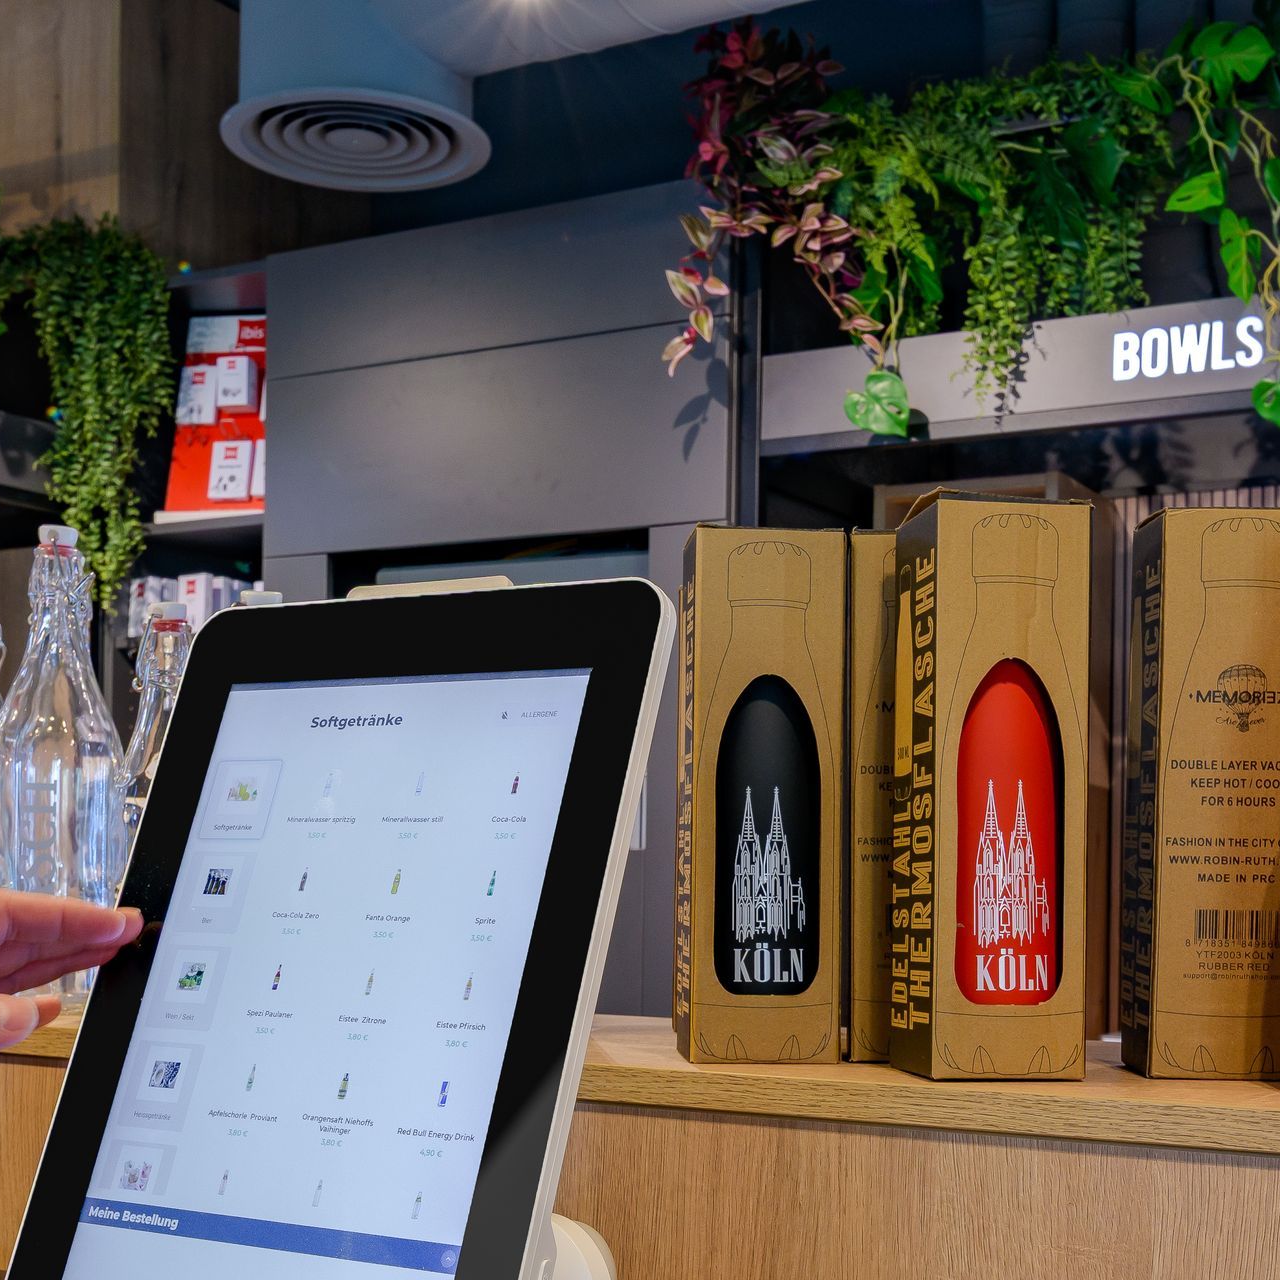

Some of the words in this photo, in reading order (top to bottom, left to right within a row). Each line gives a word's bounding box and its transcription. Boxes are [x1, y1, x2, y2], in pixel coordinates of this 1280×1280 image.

[1112, 316, 1264, 382] BOWLS
[310, 713, 403, 730] Softgetränke
[1171, 759, 1218, 770] DOUBLE
[1221, 760, 1258, 771] LAYER
[908, 547, 936, 1030] THERMOSFLASCHE
[1190, 778, 1221, 789] KEEP
[1223, 778, 1247, 789] HOT
[1201, 796, 1224, 806] FOR
[1227, 797, 1233, 807] 6
[1236, 797, 1276, 807] HOURS
[332, 816, 356, 825] spritzig
[213, 824, 252, 832] Softgetränke
[1165, 837, 1213, 847] FASHION
[1215, 837, 1224, 847] IN
[1228, 837, 1249, 848] THE
[1251, 838, 1275, 848] CITY
[1197, 873, 1230, 883] MADE
[1235, 874, 1247, 883] IN
[1252, 874, 1276, 884] PRC
[272, 911, 303, 919] Coca-Cola
[385, 914, 411, 924] Orange
[891, 801, 911, 1029] EDELSTAHL
[475, 917, 496, 926] Sprite
[1196, 950, 1242, 959] YTF2003
[1244, 950, 1275, 960] KÖLN
[733, 942, 805, 984] KÖLN
[1198, 962, 1244, 971] RUBBER
[1247, 963, 1271, 972] RED
[975, 948, 1048, 991] KÖLN
[247, 1009, 264, 1018] Spezi
[265, 1010, 293, 1019] Paulaner
[338, 1015, 359, 1023] Eistee
[361, 1016, 387, 1025] Zitrone
[436, 1021, 458, 1029] Eistee
[459, 1022, 486, 1031] Pfirsich
[208, 1109, 248, 1121] Apfelschorle
[250, 1113, 278, 1123] Proviant
[302, 1113, 345, 1128] Orangensaft
[345, 1117, 374, 1128] Niehoffs
[319, 1125, 351, 1136] Vaihinger
[396, 1127, 411, 1136] Red
[412, 1128, 427, 1137] Bull
[428, 1130, 454, 1142] Energy
[454, 1132, 475, 1142] Drink
[88, 1205, 121, 1222] Meine
[121, 1210, 180, 1230] Bestellung
